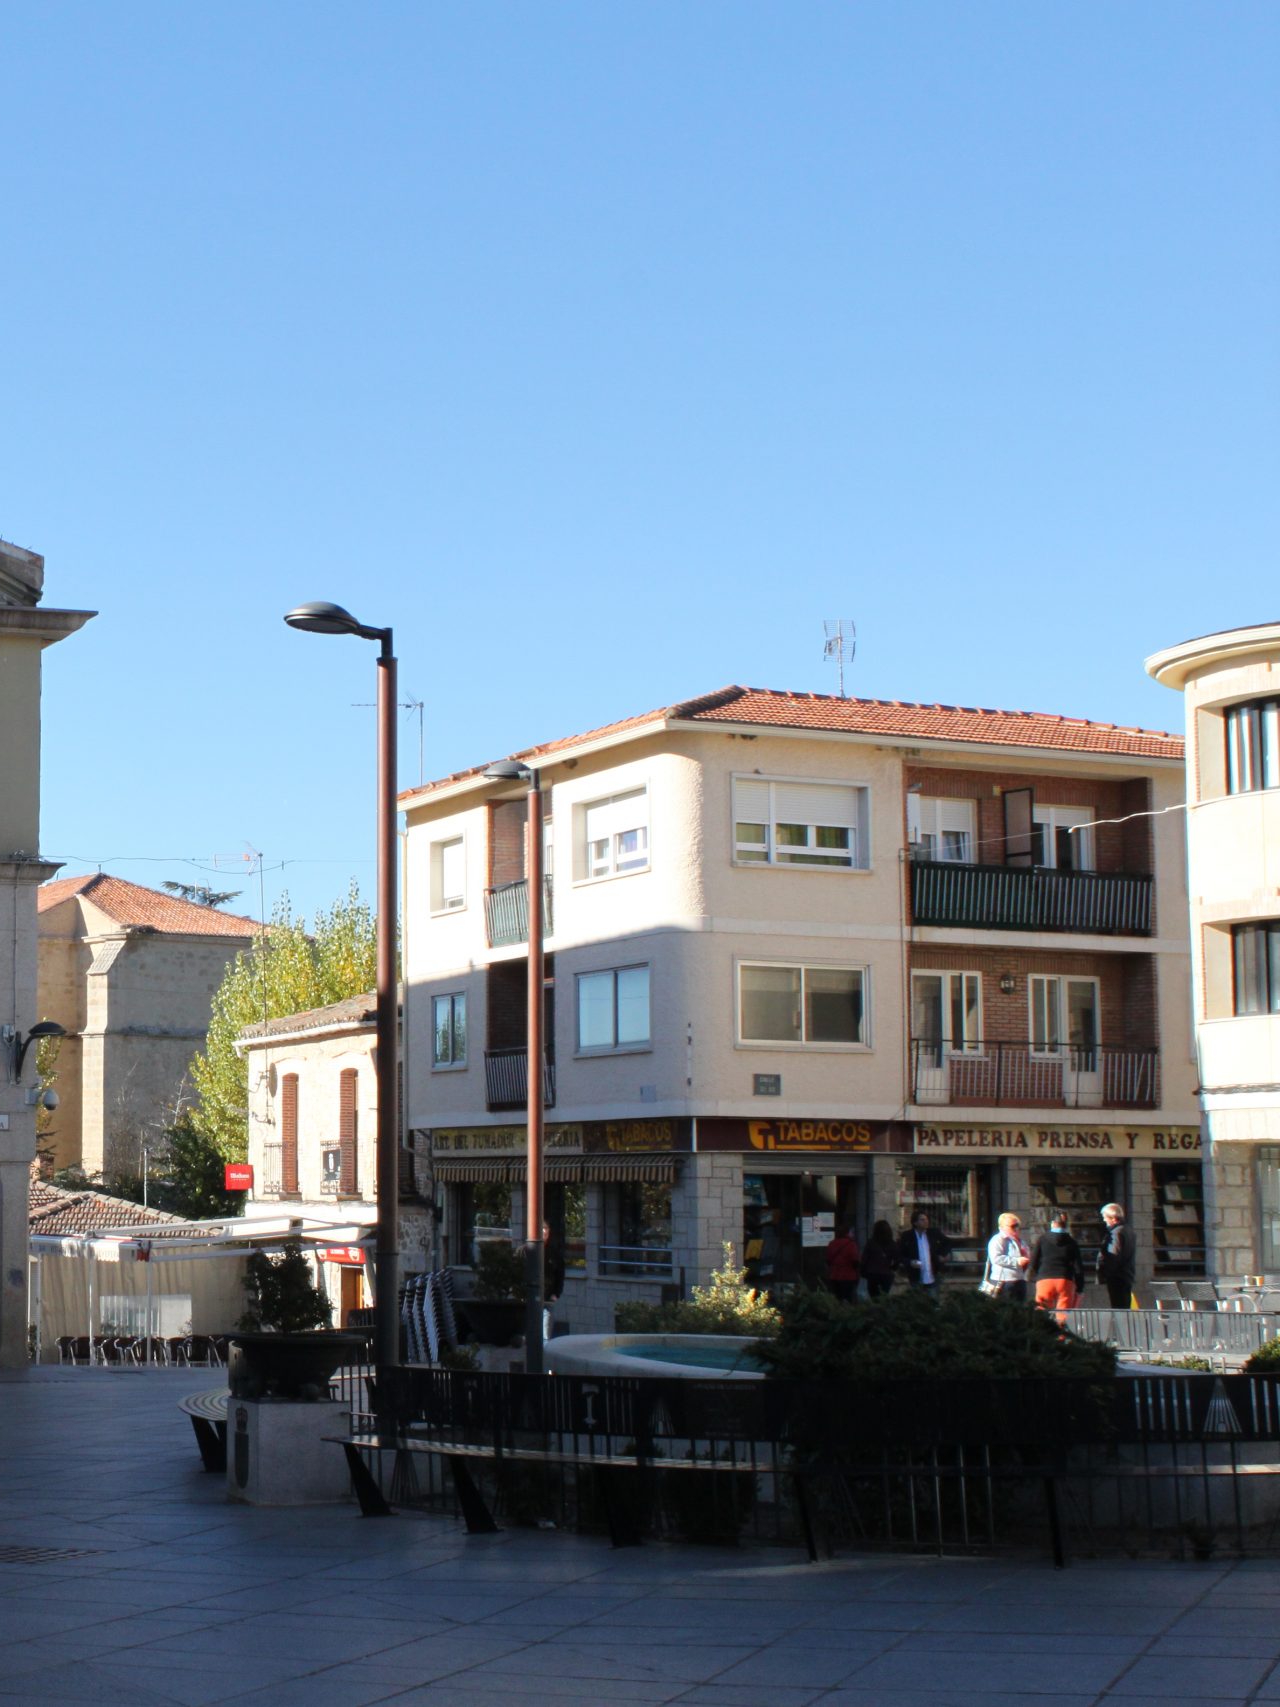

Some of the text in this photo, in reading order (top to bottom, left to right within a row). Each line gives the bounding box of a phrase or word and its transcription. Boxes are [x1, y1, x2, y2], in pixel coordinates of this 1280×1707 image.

[775, 1121, 871, 1142] TABACOS
[918, 1128, 1028, 1148] PAPELERIA
[1038, 1131, 1113, 1149] PRENSA
[1126, 1132, 1139, 1149] Y
